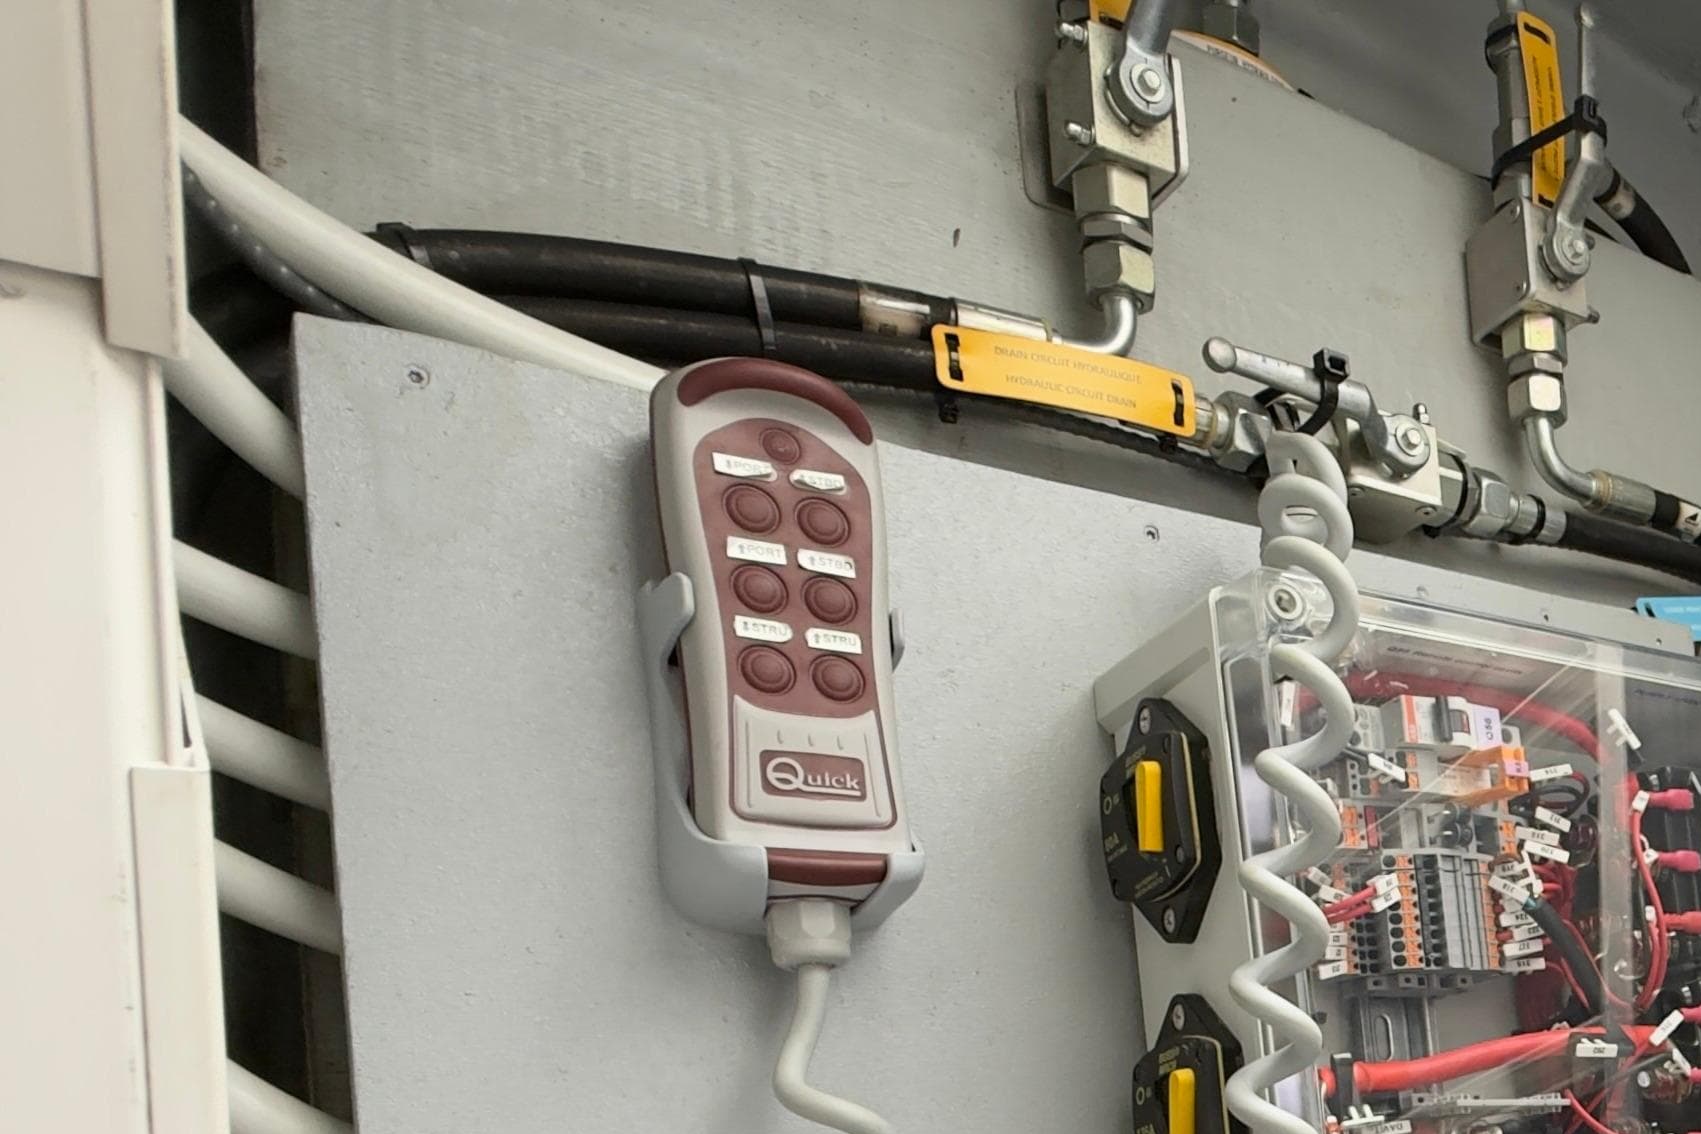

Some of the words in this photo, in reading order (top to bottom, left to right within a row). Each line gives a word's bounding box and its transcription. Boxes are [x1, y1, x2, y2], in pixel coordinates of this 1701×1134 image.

[994, 345, 1028, 360] DRAIN
[1030, 352, 1069, 367] CIRCUIT
[1005, 373, 1064, 393] HYDRAULIC
[1065, 384, 1104, 401] CIRCUIT
[1106, 394, 1137, 409] DRAIN
[748, 544, 785, 560] PORT
[818, 554, 854, 571] STBD
[751, 621, 789, 637] STRU
[823, 632, 858, 648] STRU
[766, 757, 861, 797] Quick
